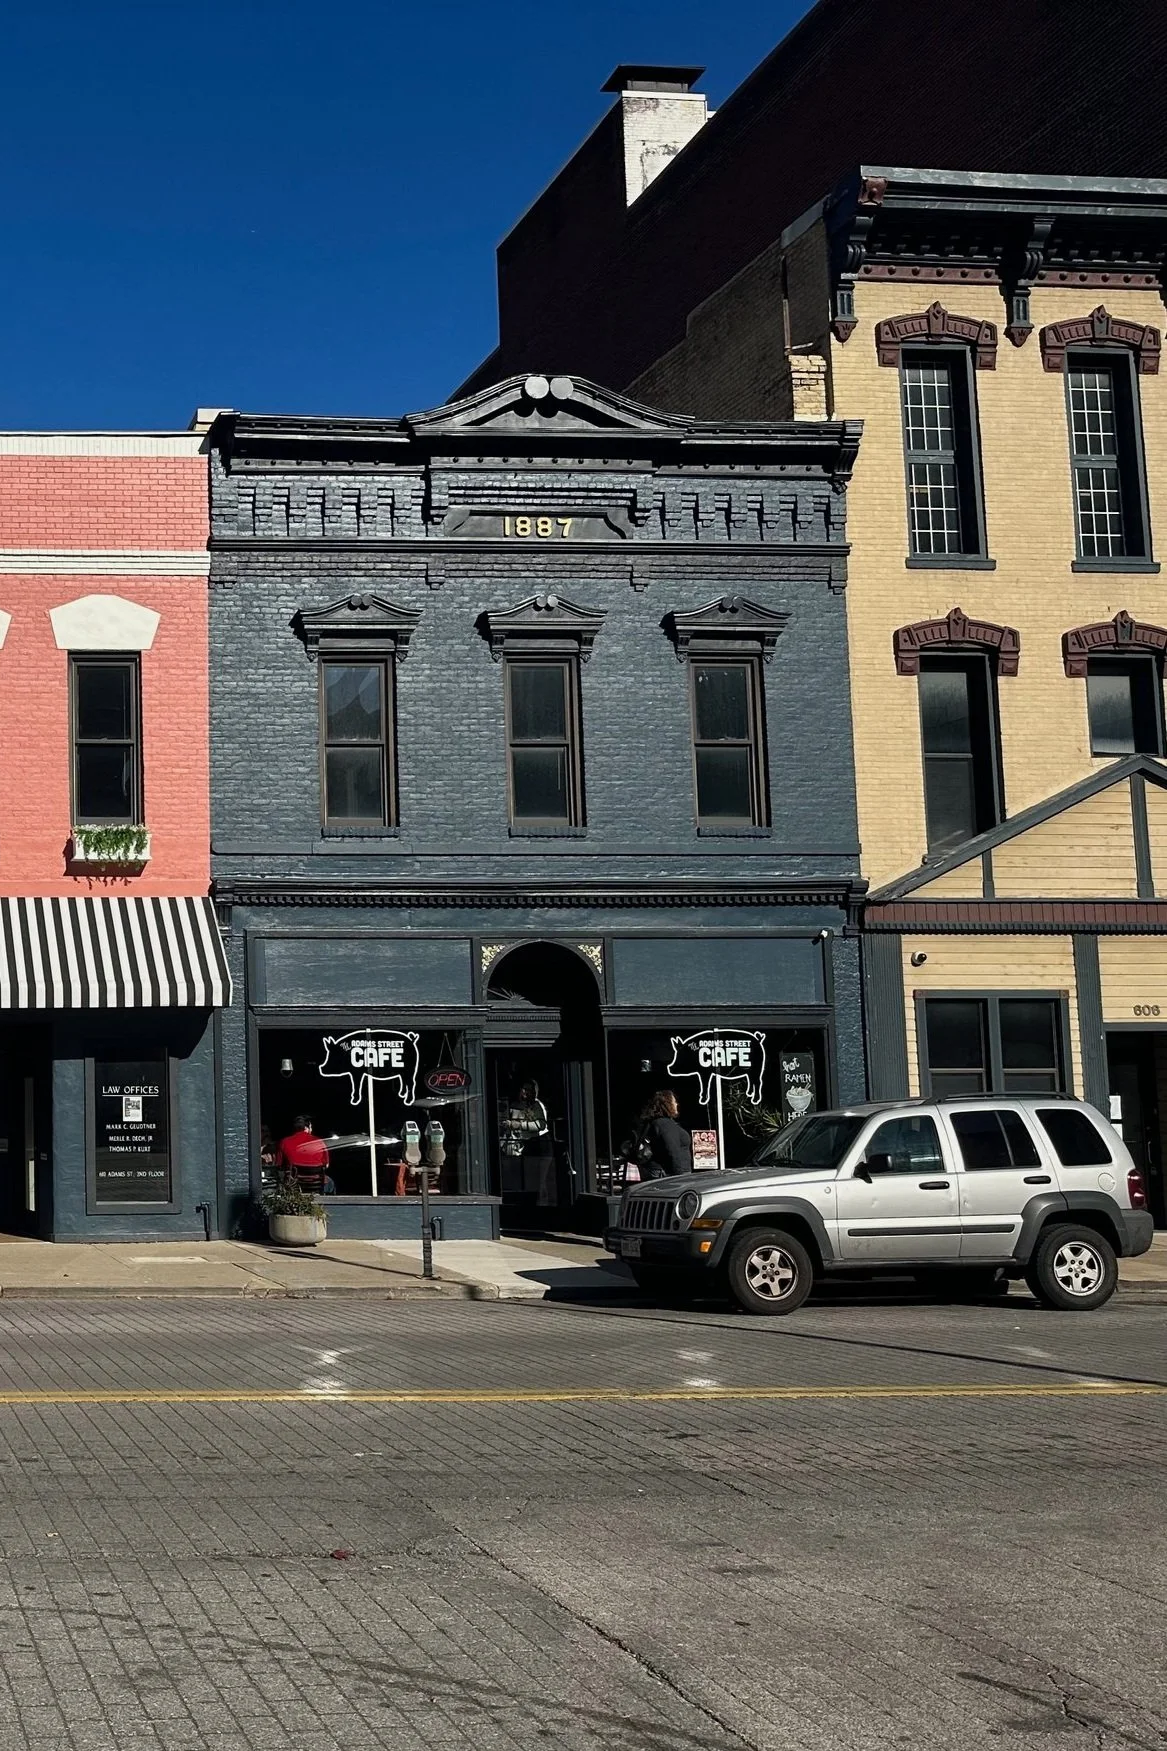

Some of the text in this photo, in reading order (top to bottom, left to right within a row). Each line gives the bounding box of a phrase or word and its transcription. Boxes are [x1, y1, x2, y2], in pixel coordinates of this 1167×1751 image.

[504, 516, 573, 537] 1887
[1133, 1004, 1161, 1016] 606
[350, 1047, 405, 1068] CAFE
[698, 1047, 751, 1067] CAFE
[783, 1057, 800, 1072] hot
[428, 1073, 465, 1087] OPEN
[785, 1073, 811, 1083] RAMEN
[102, 1086, 159, 1094] LAW OFFICES
